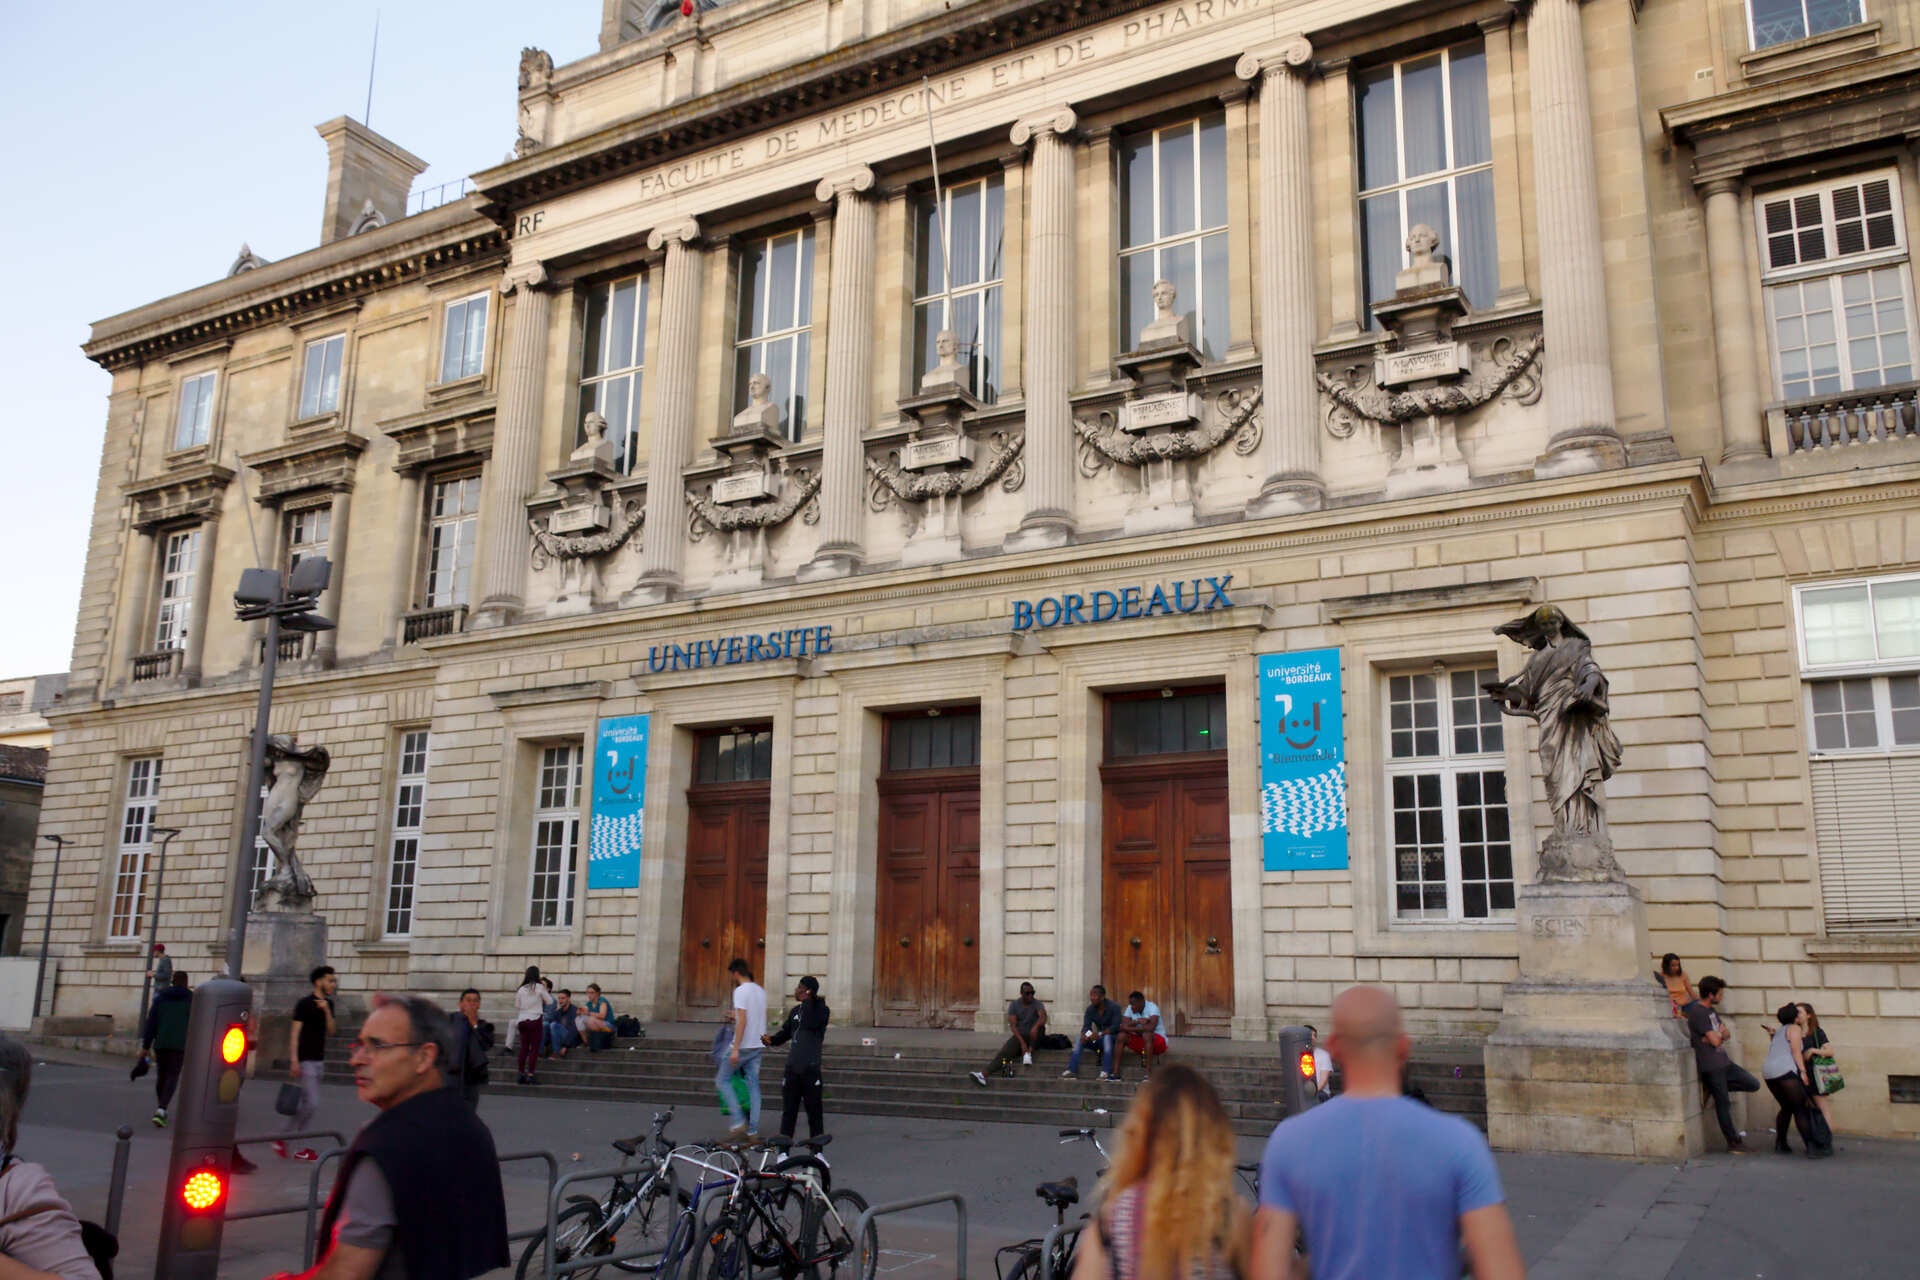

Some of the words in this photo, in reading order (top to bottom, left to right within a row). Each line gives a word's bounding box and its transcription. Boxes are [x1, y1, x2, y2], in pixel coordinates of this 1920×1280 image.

[640, 147, 745, 198] FACULTE
[766, 129, 800, 159] DE
[817, 76, 967, 140] MEDECINE
[992, 54, 1035, 88] ET
[1054, 35, 1096, 72] DE
[1123, 0, 1260, 48] PHARM
[518, 210, 545, 236] RF
[1011, 575, 1235, 631] BORDEAUX
[649, 624, 833, 673] UNIVERSITE
[1285, 672, 1332, 685] BORDEAUX
